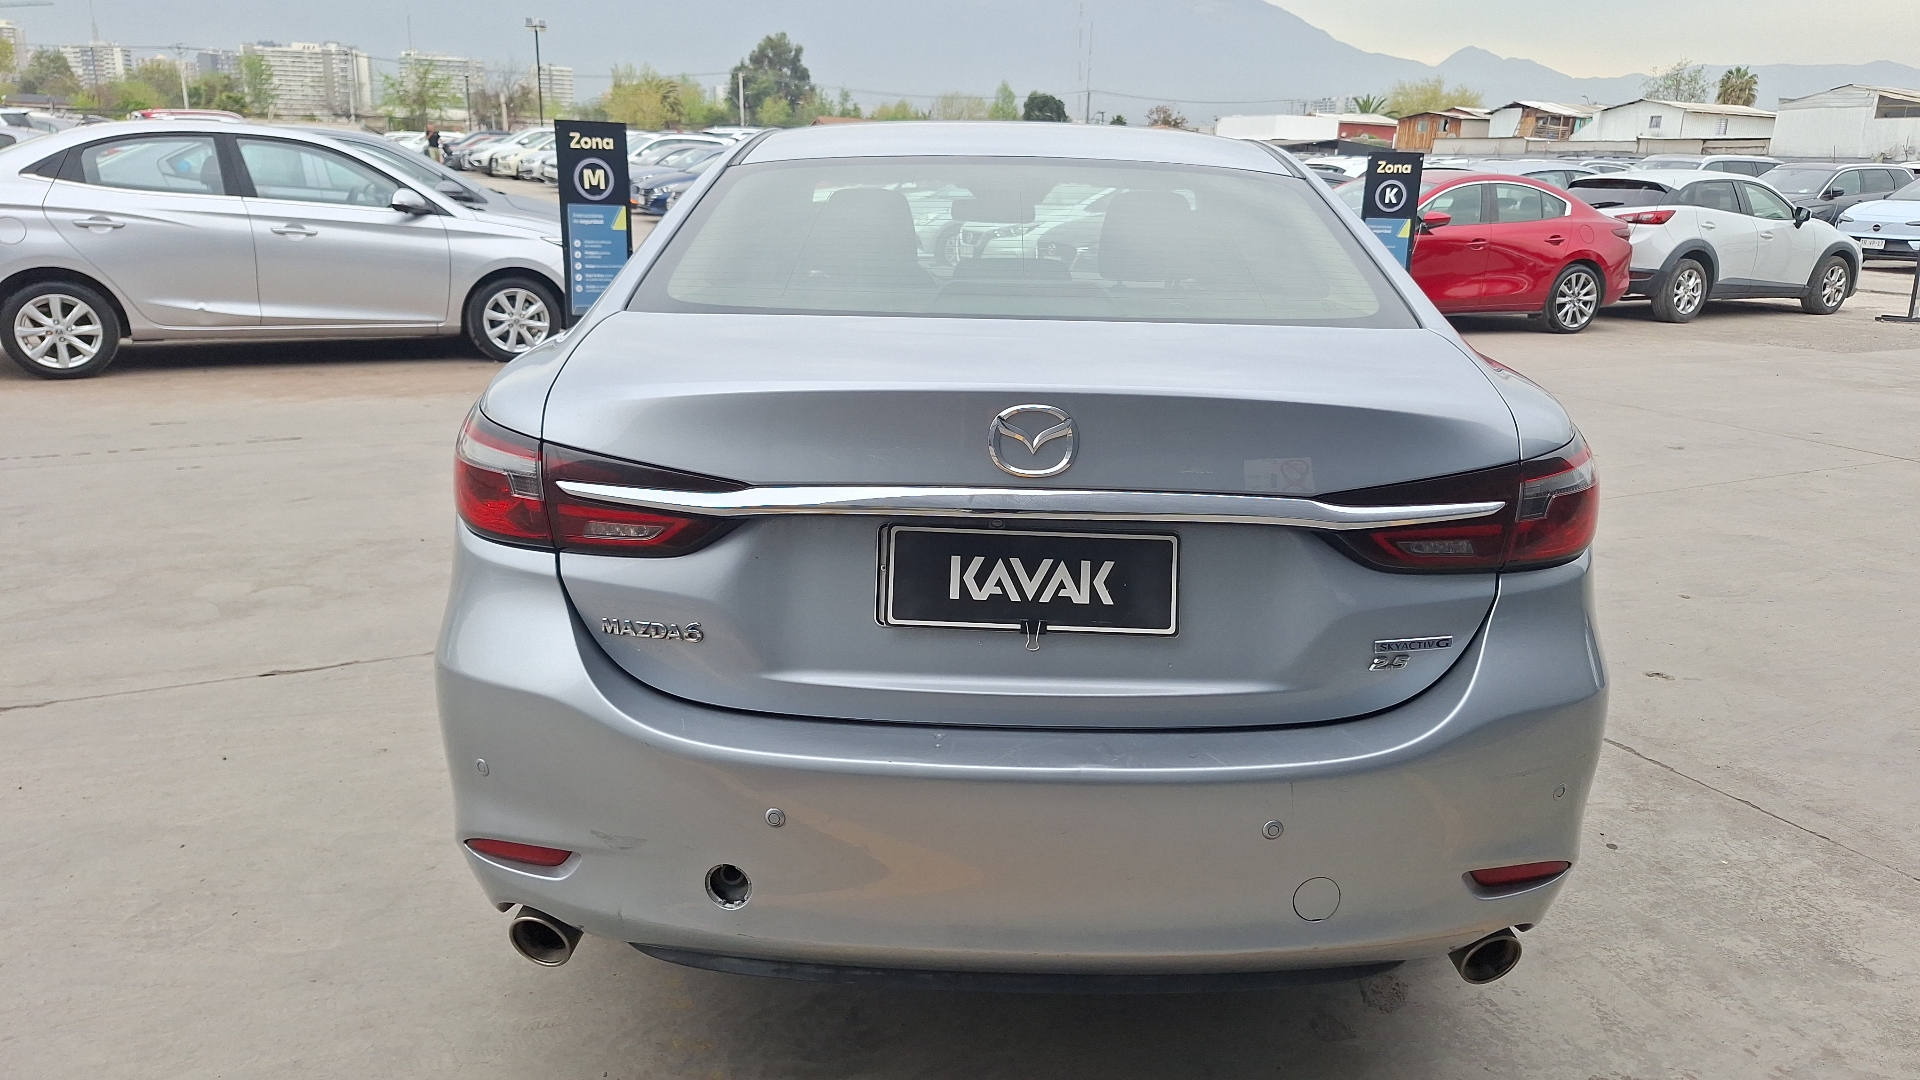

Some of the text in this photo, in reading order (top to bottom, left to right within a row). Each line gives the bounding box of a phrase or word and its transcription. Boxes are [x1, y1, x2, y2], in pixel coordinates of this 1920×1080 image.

[569, 131, 614, 150] Zona
[1376, 160, 1412, 174] Zona
[583, 168, 606, 190] M
[1384, 187, 1399, 204] K
[949, 555, 1115, 606] KAVAK
[1368, 655, 1411, 672] 2.5
